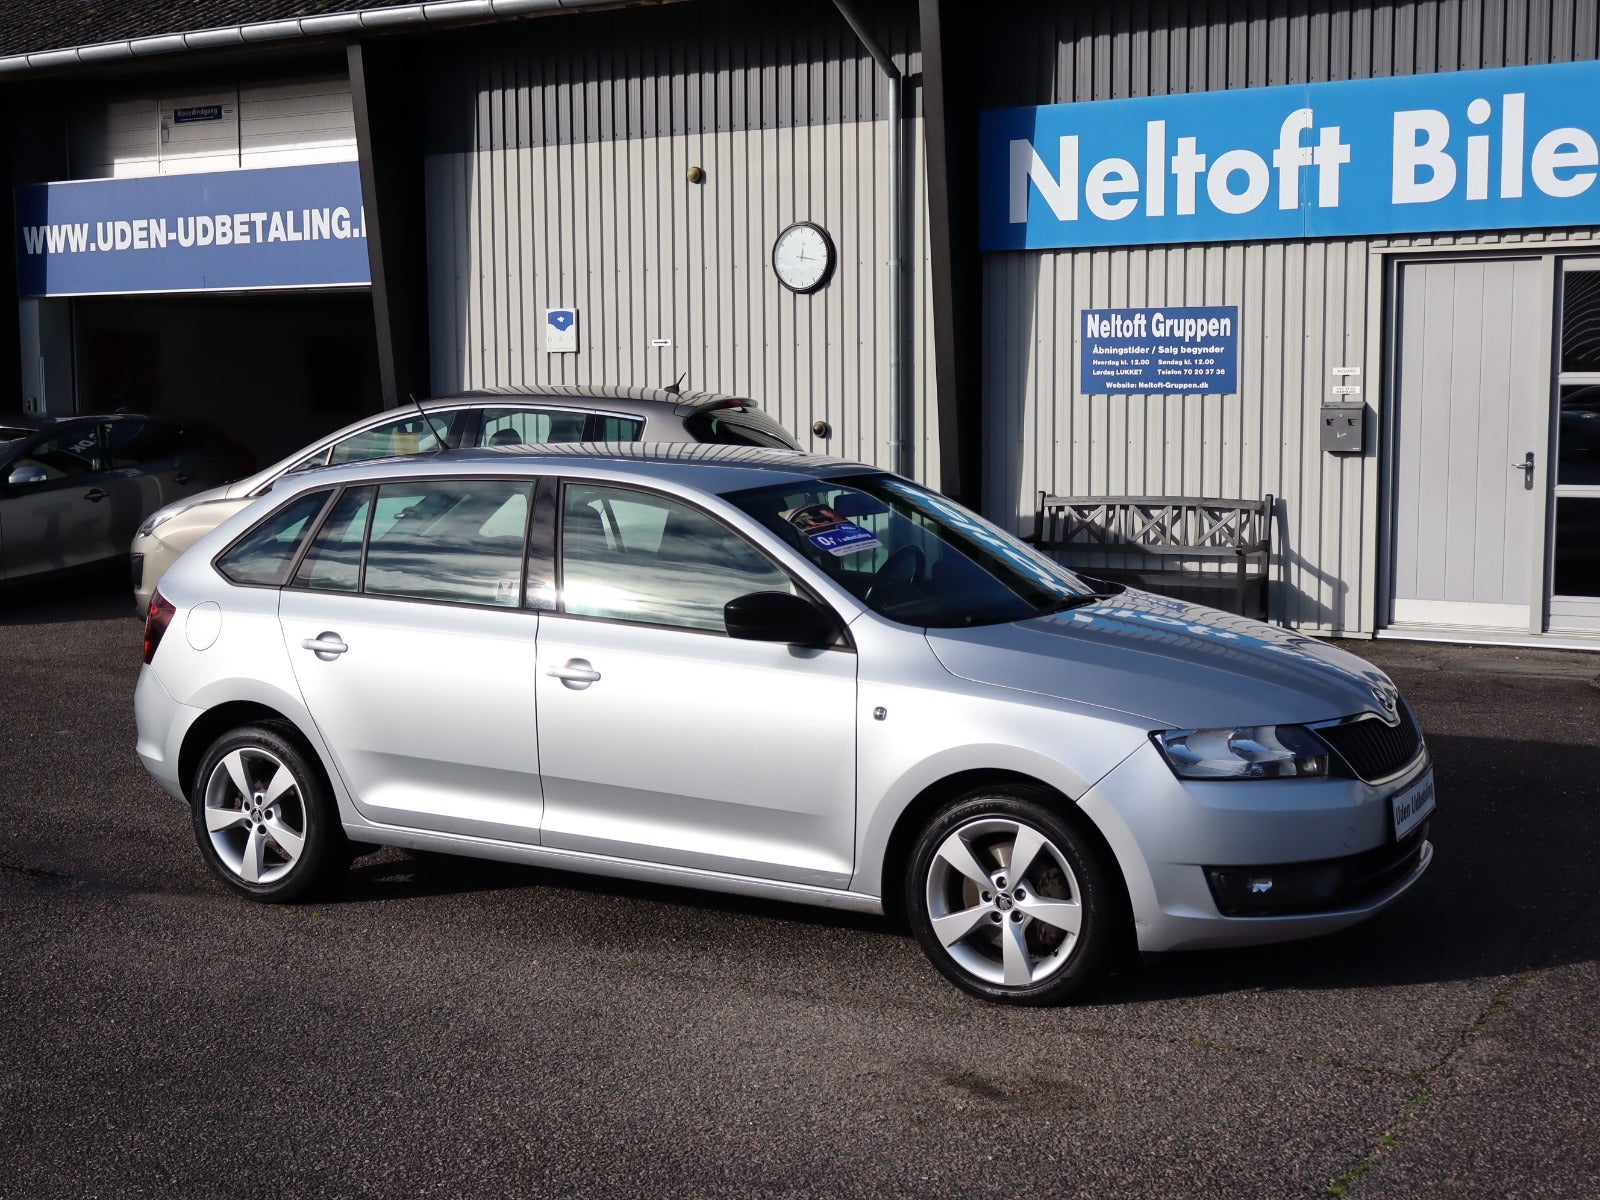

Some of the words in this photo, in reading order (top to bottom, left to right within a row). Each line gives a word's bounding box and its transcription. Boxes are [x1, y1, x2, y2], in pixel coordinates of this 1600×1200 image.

[1009, 107, 1351, 224] Neltoft
[1392, 92, 1599, 205] Bile
[1087, 313, 1147, 338] Neltoft
[1151, 312, 1231, 342] Gruppen
[1092, 344, 1149, 355] Åbningstider
[1158, 346, 1179, 355] Salg
[1180, 345, 1225, 355] begynder
[1157, 358, 1183, 366] Søndag
[1092, 369, 1115, 377] Lørdag
[1106, 381, 1137, 389] Website:
[1138, 381, 1209, 390] Neltoft-Gruppen.dk
[1395, 803, 1411, 826] Uden
